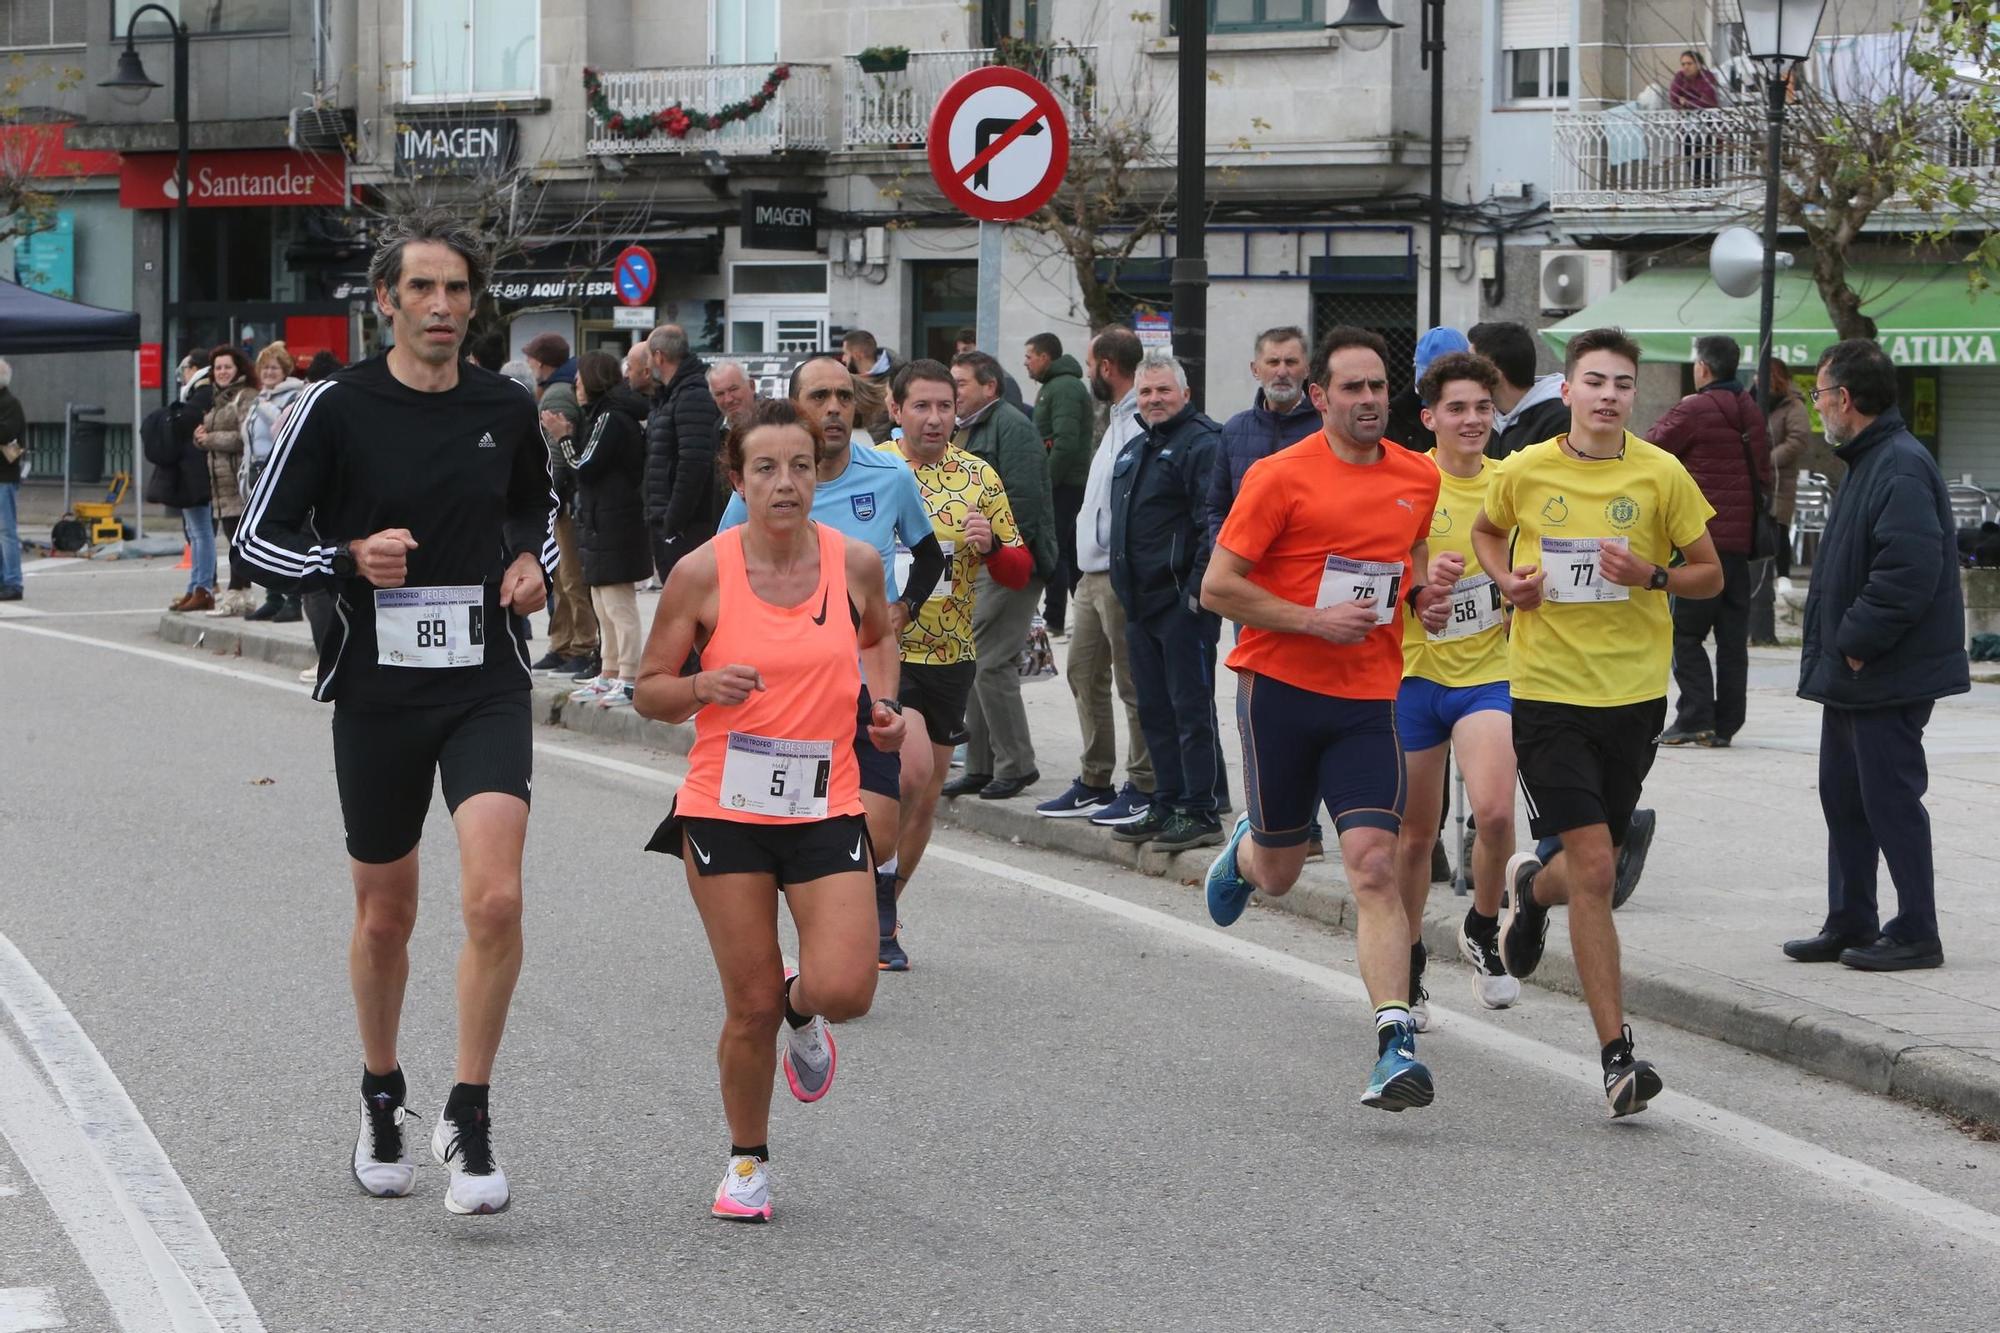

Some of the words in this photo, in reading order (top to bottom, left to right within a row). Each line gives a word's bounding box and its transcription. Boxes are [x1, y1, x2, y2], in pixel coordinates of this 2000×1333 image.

[404, 128, 498, 159] IMAGEN
[199, 164, 314, 197] Santander
[756, 206, 812, 226] IMAGEN
[505, 284, 529, 297] BAR
[531, 280, 566, 297] AQUÍ
[1571, 563, 1594, 586] 77
[395, 591, 419, 599] TROFEO
[1454, 600, 1477, 623] 58
[417, 620, 447, 647] 89
[749, 738, 772, 748] TROFEO
[770, 770, 786, 797] 5
